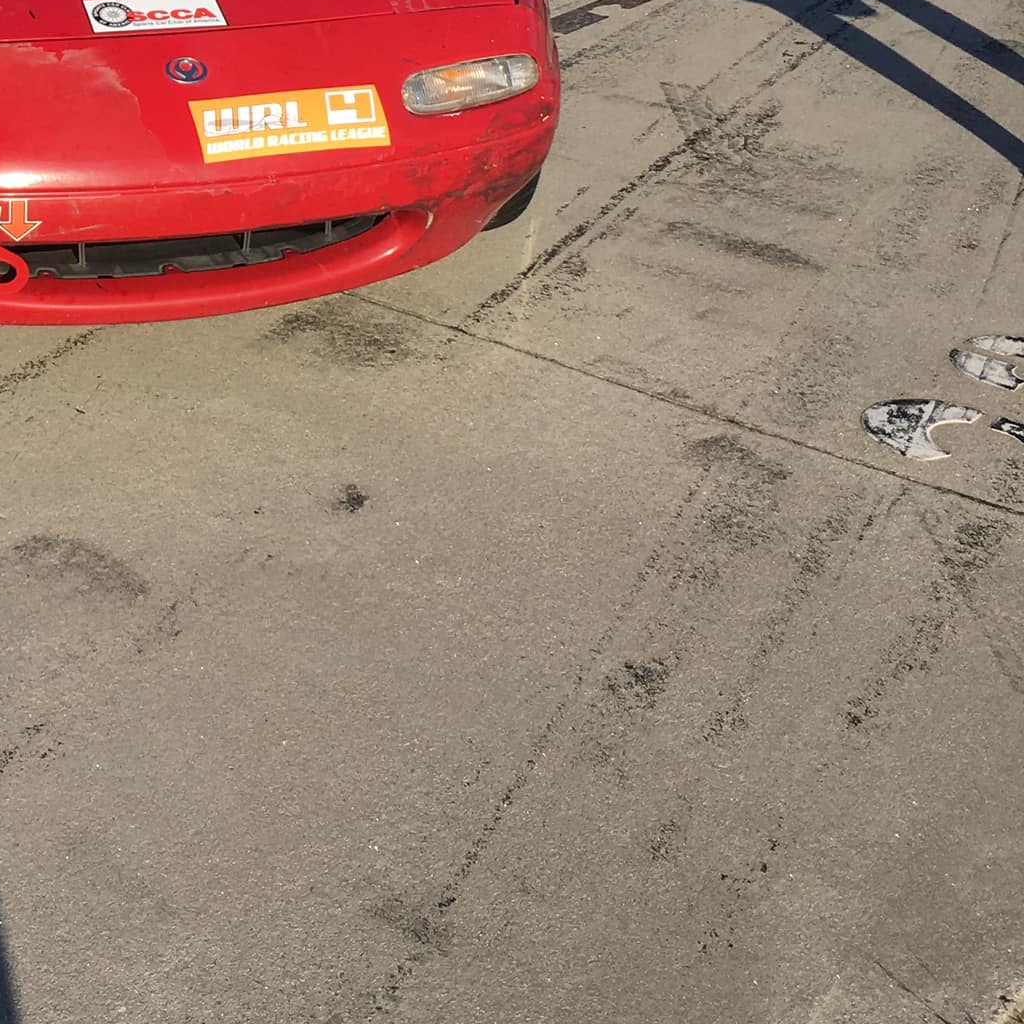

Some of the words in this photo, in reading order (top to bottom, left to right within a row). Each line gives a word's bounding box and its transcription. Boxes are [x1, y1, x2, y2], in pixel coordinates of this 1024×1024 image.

[127, 8, 216, 22] SCCA
[203, 101, 308, 138] WRL
[207, 137, 264, 154] WORLD
[267, 130, 328, 147] RACING
[330, 126, 385, 142] LEAGUE
